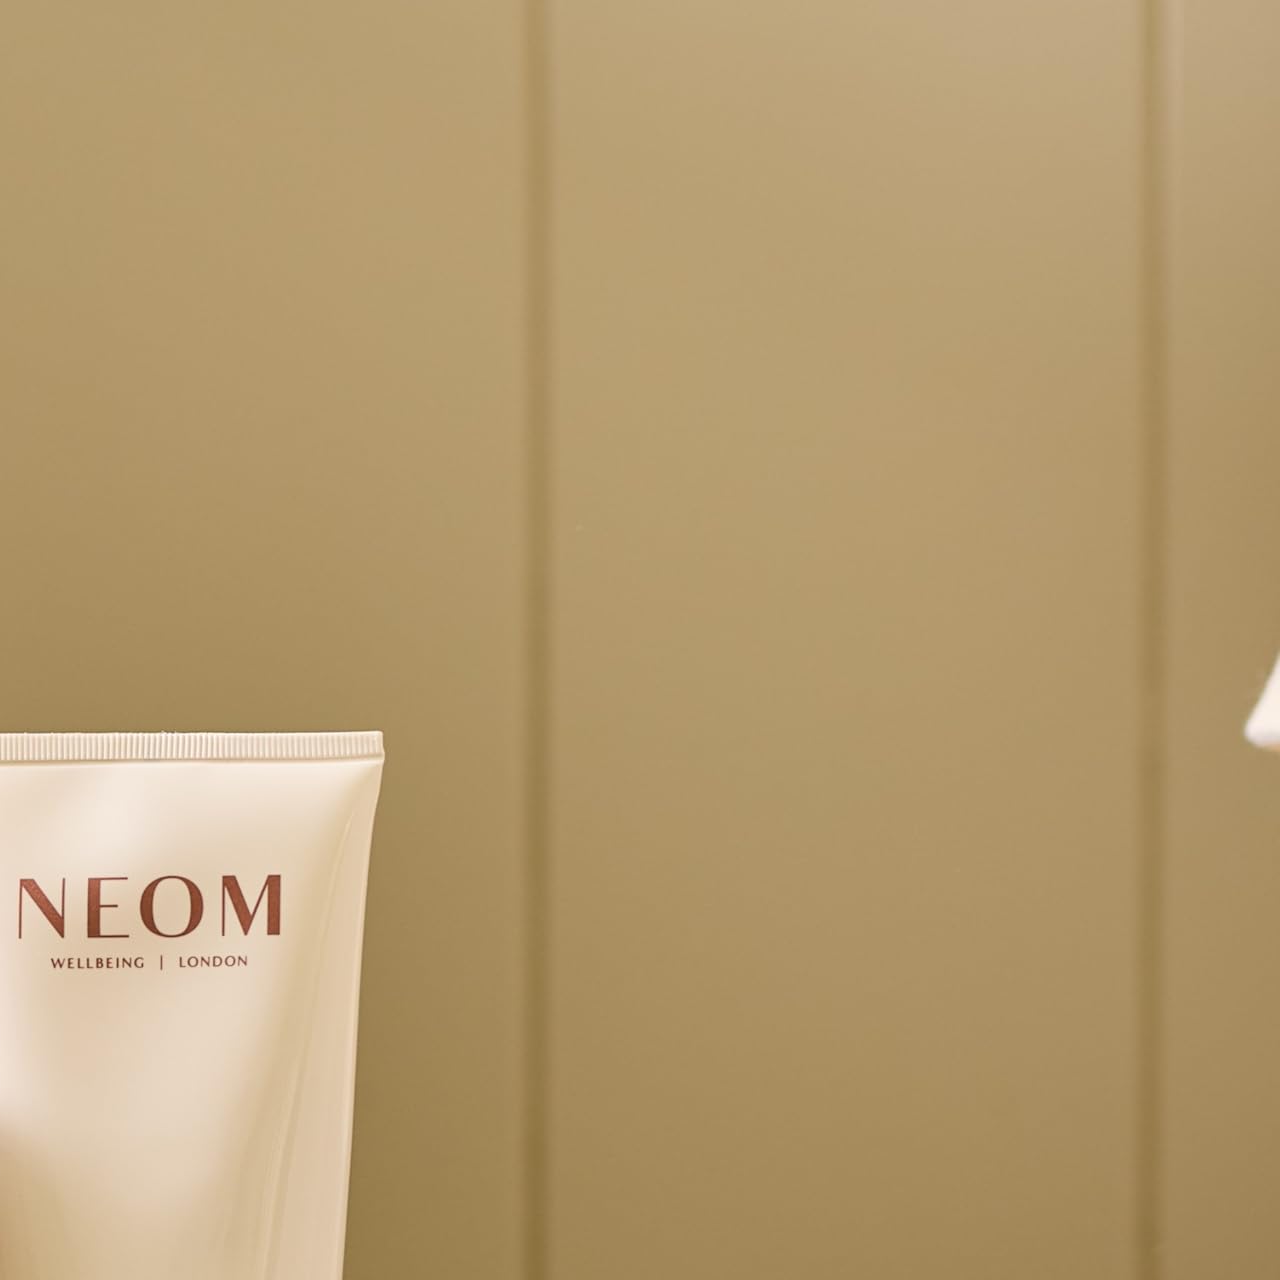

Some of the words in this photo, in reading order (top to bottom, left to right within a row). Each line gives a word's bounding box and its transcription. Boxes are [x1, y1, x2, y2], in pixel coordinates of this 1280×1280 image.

[18, 874, 281, 939] NEOM
[50, 956, 145, 970] WELLBEING
[179, 955, 248, 968] LONDON
